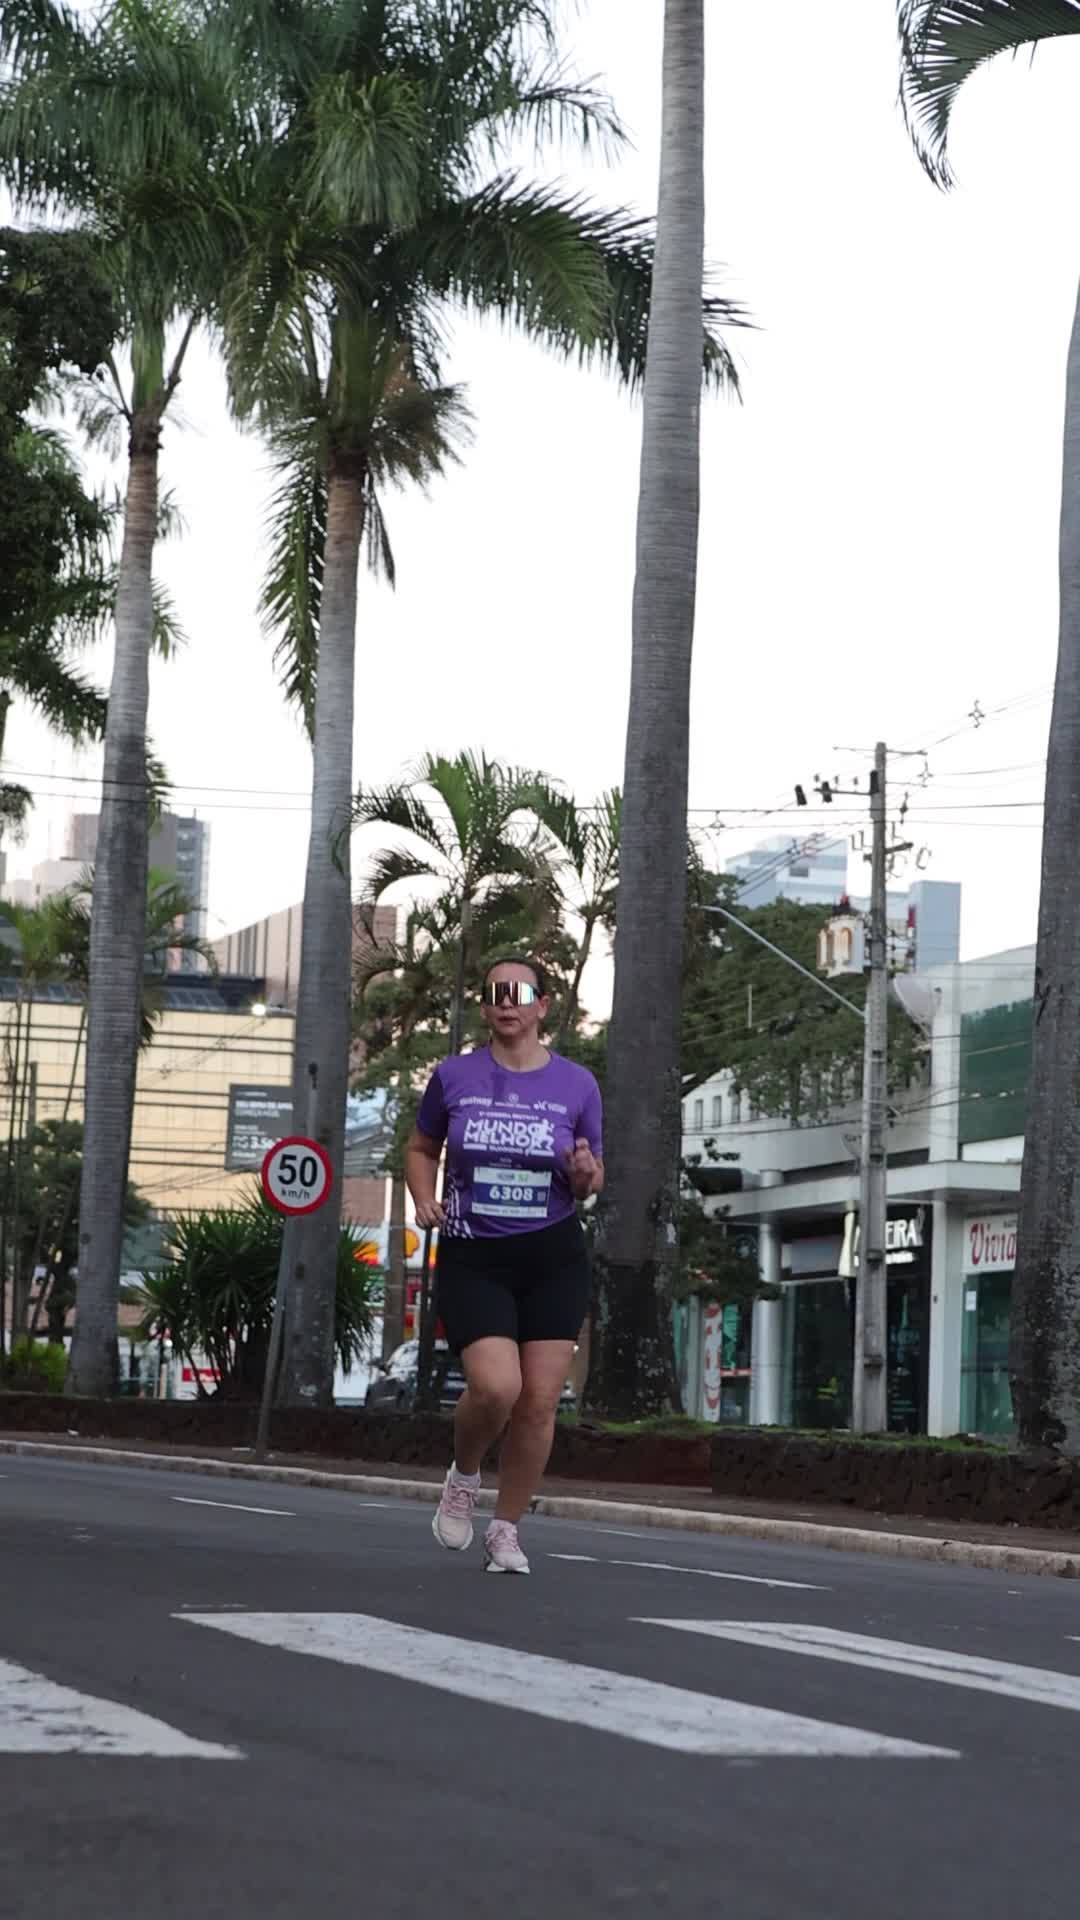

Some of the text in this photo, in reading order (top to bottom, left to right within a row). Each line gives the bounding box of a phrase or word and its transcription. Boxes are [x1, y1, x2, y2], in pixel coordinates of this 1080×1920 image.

[466, 1119, 545, 1136] MUNDO
[464, 1131, 554, 1151] MELHOR
[278, 1154, 318, 1187] 50
[281, 1189, 310, 1199] km/h
[489, 1186, 533, 1201] 6308
